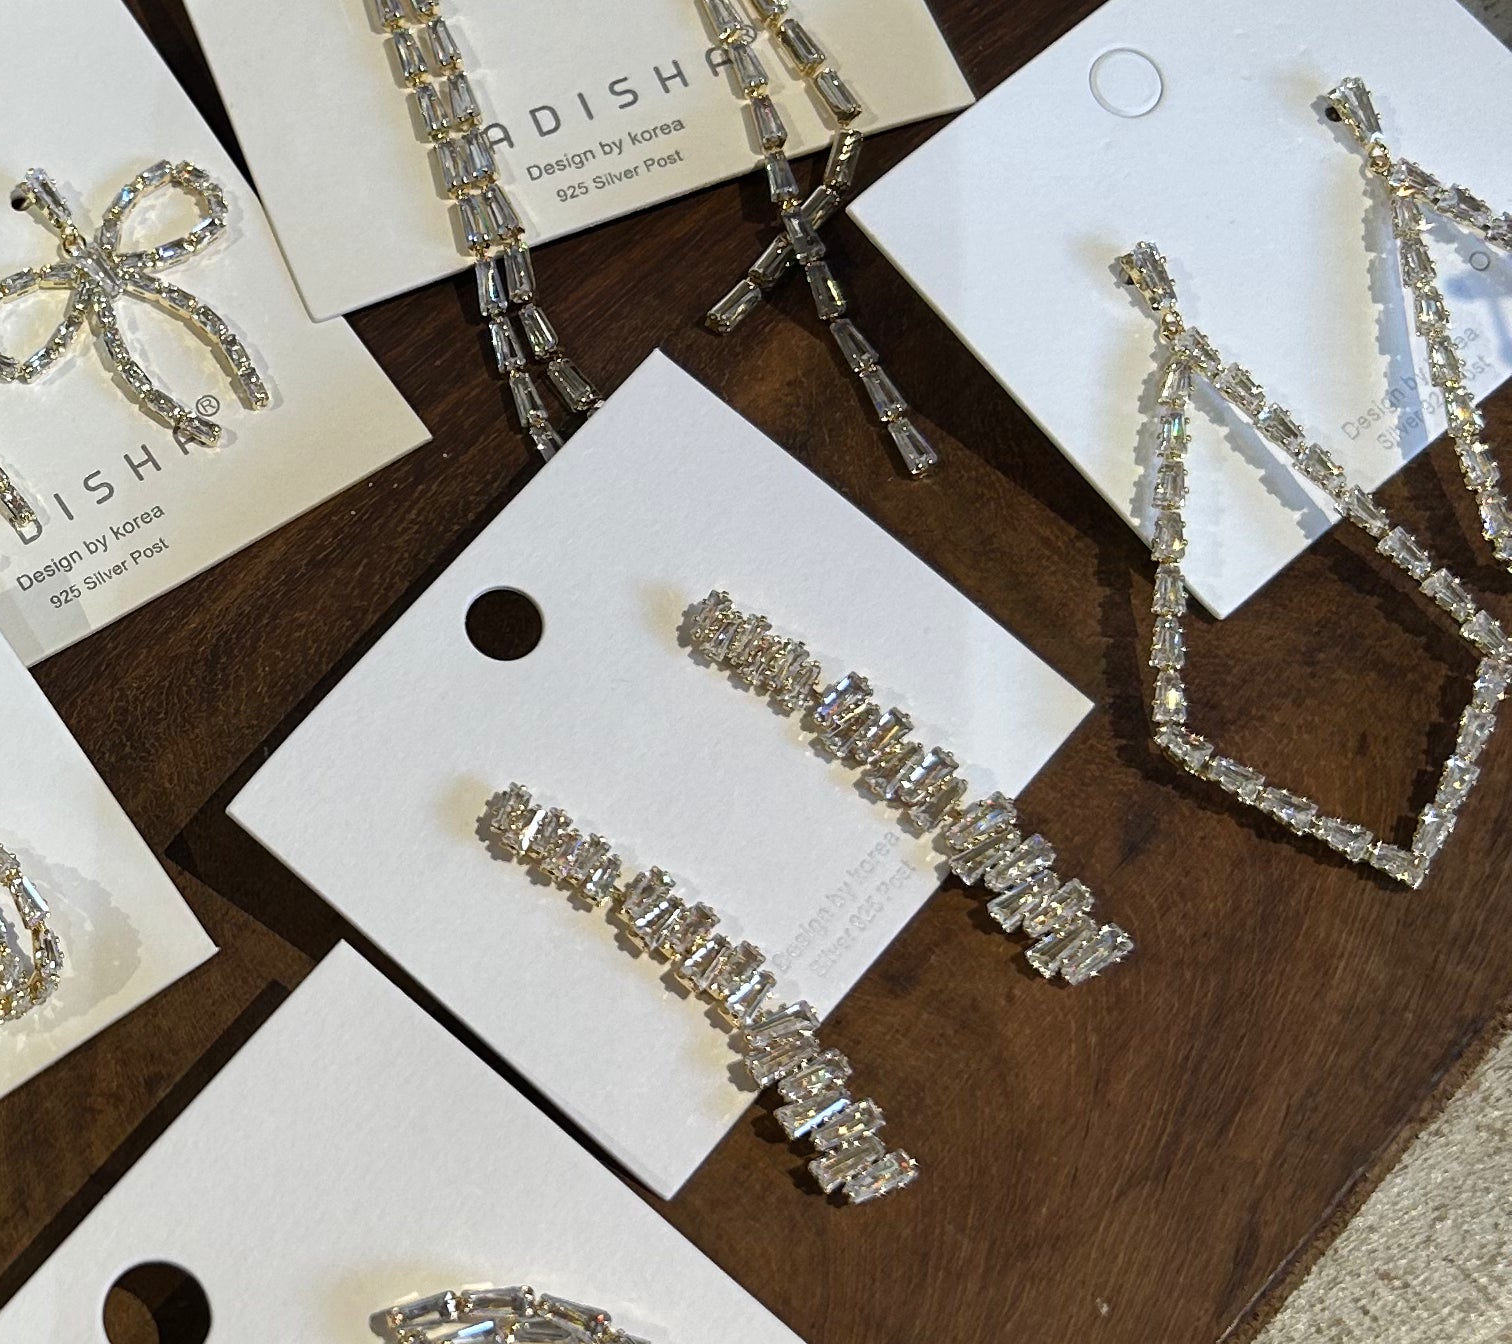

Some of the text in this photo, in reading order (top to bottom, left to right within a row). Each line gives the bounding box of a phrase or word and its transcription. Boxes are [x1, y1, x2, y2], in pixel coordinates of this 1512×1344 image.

[526, 117, 686, 182] Design by korea
[556, 149, 685, 203] 925 Silver Post
[1340, 387, 1406, 441] Design
[1376, 409, 1424, 450] Silver
[1465, 355, 1491, 382] ost
[16, 506, 166, 592] Design by korea
[49, 537, 170, 610] 925 Silver Post
